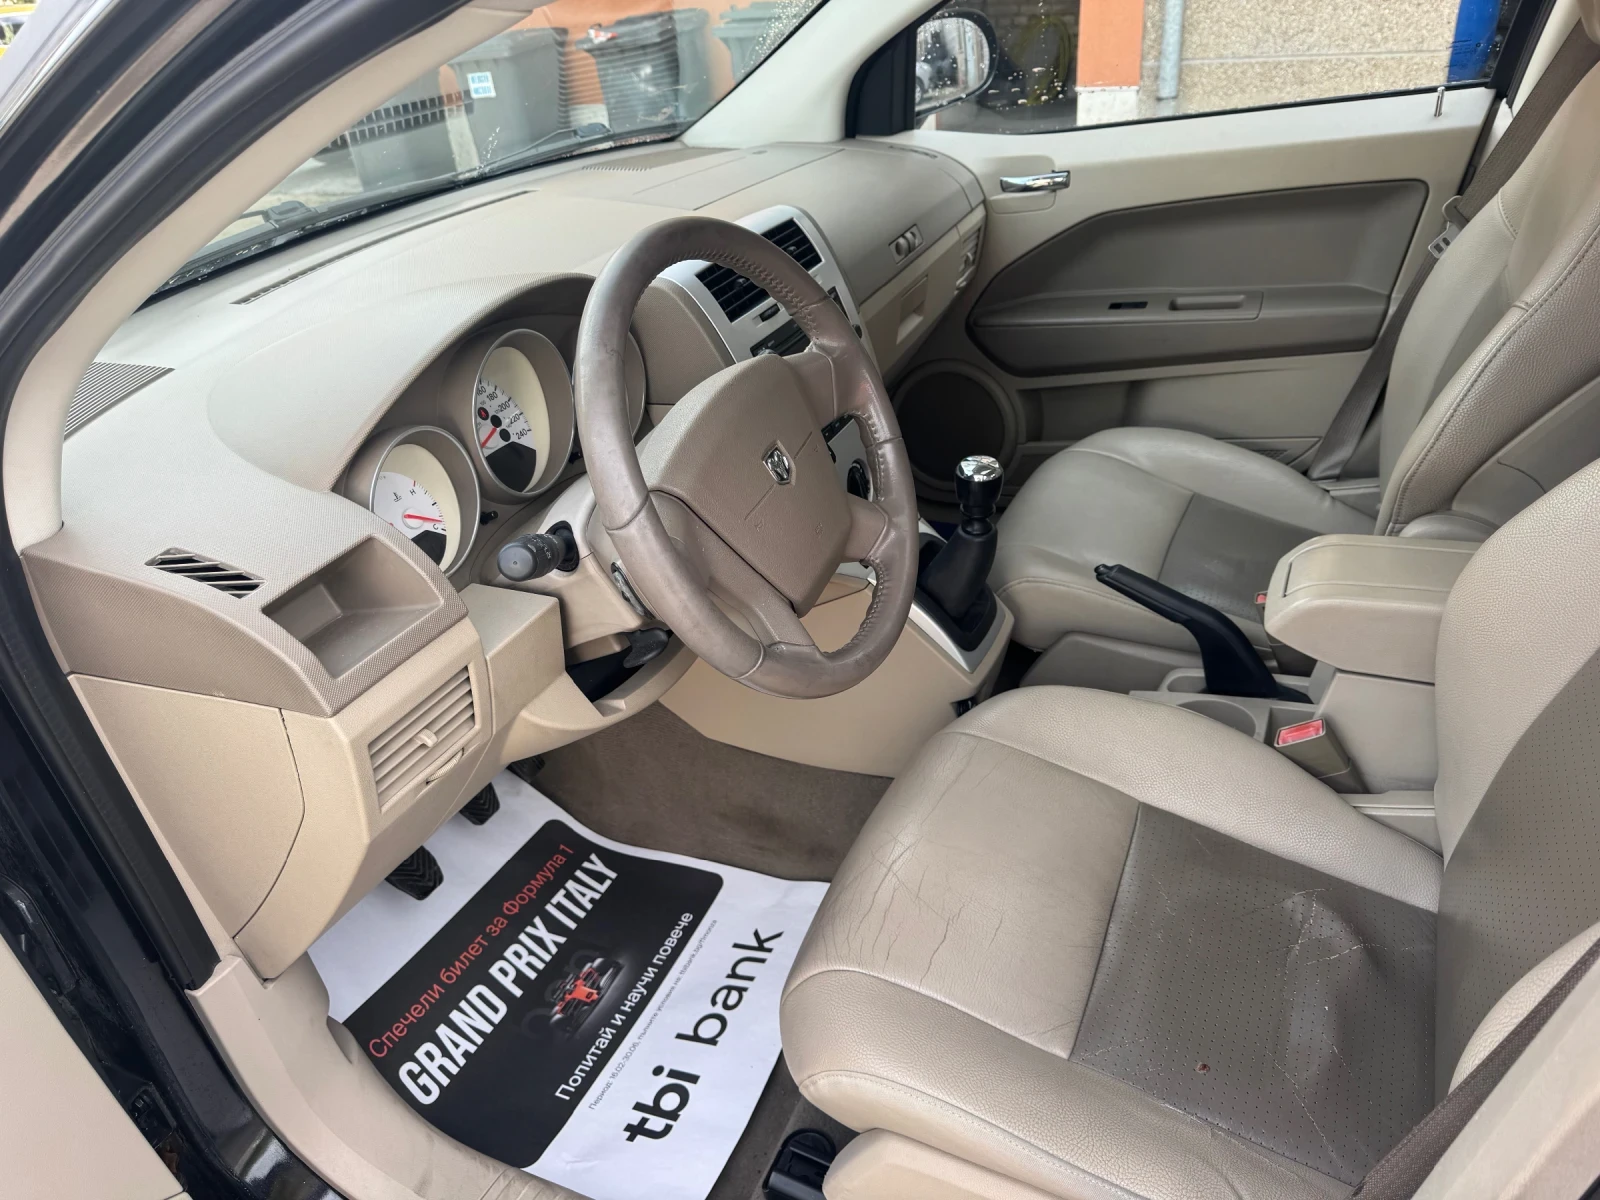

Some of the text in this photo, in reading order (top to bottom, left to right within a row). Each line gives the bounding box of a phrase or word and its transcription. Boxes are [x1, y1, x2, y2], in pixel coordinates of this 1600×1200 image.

[486, 391, 498, 402] 180
[498, 401, 511, 413] 200
[510, 413, 520, 425] 220
[515, 428, 528, 440] 240
[409, 488, 417, 496] H
[432, 523, 439, 531] C
[368, 844, 574, 1058] Спечели билет за Формула 1
[398, 852, 618, 1105] GRAND PRIX ITALY
[554, 912, 694, 1101] Попитай и научи повече
[622, 928, 785, 1143] tbi bank
